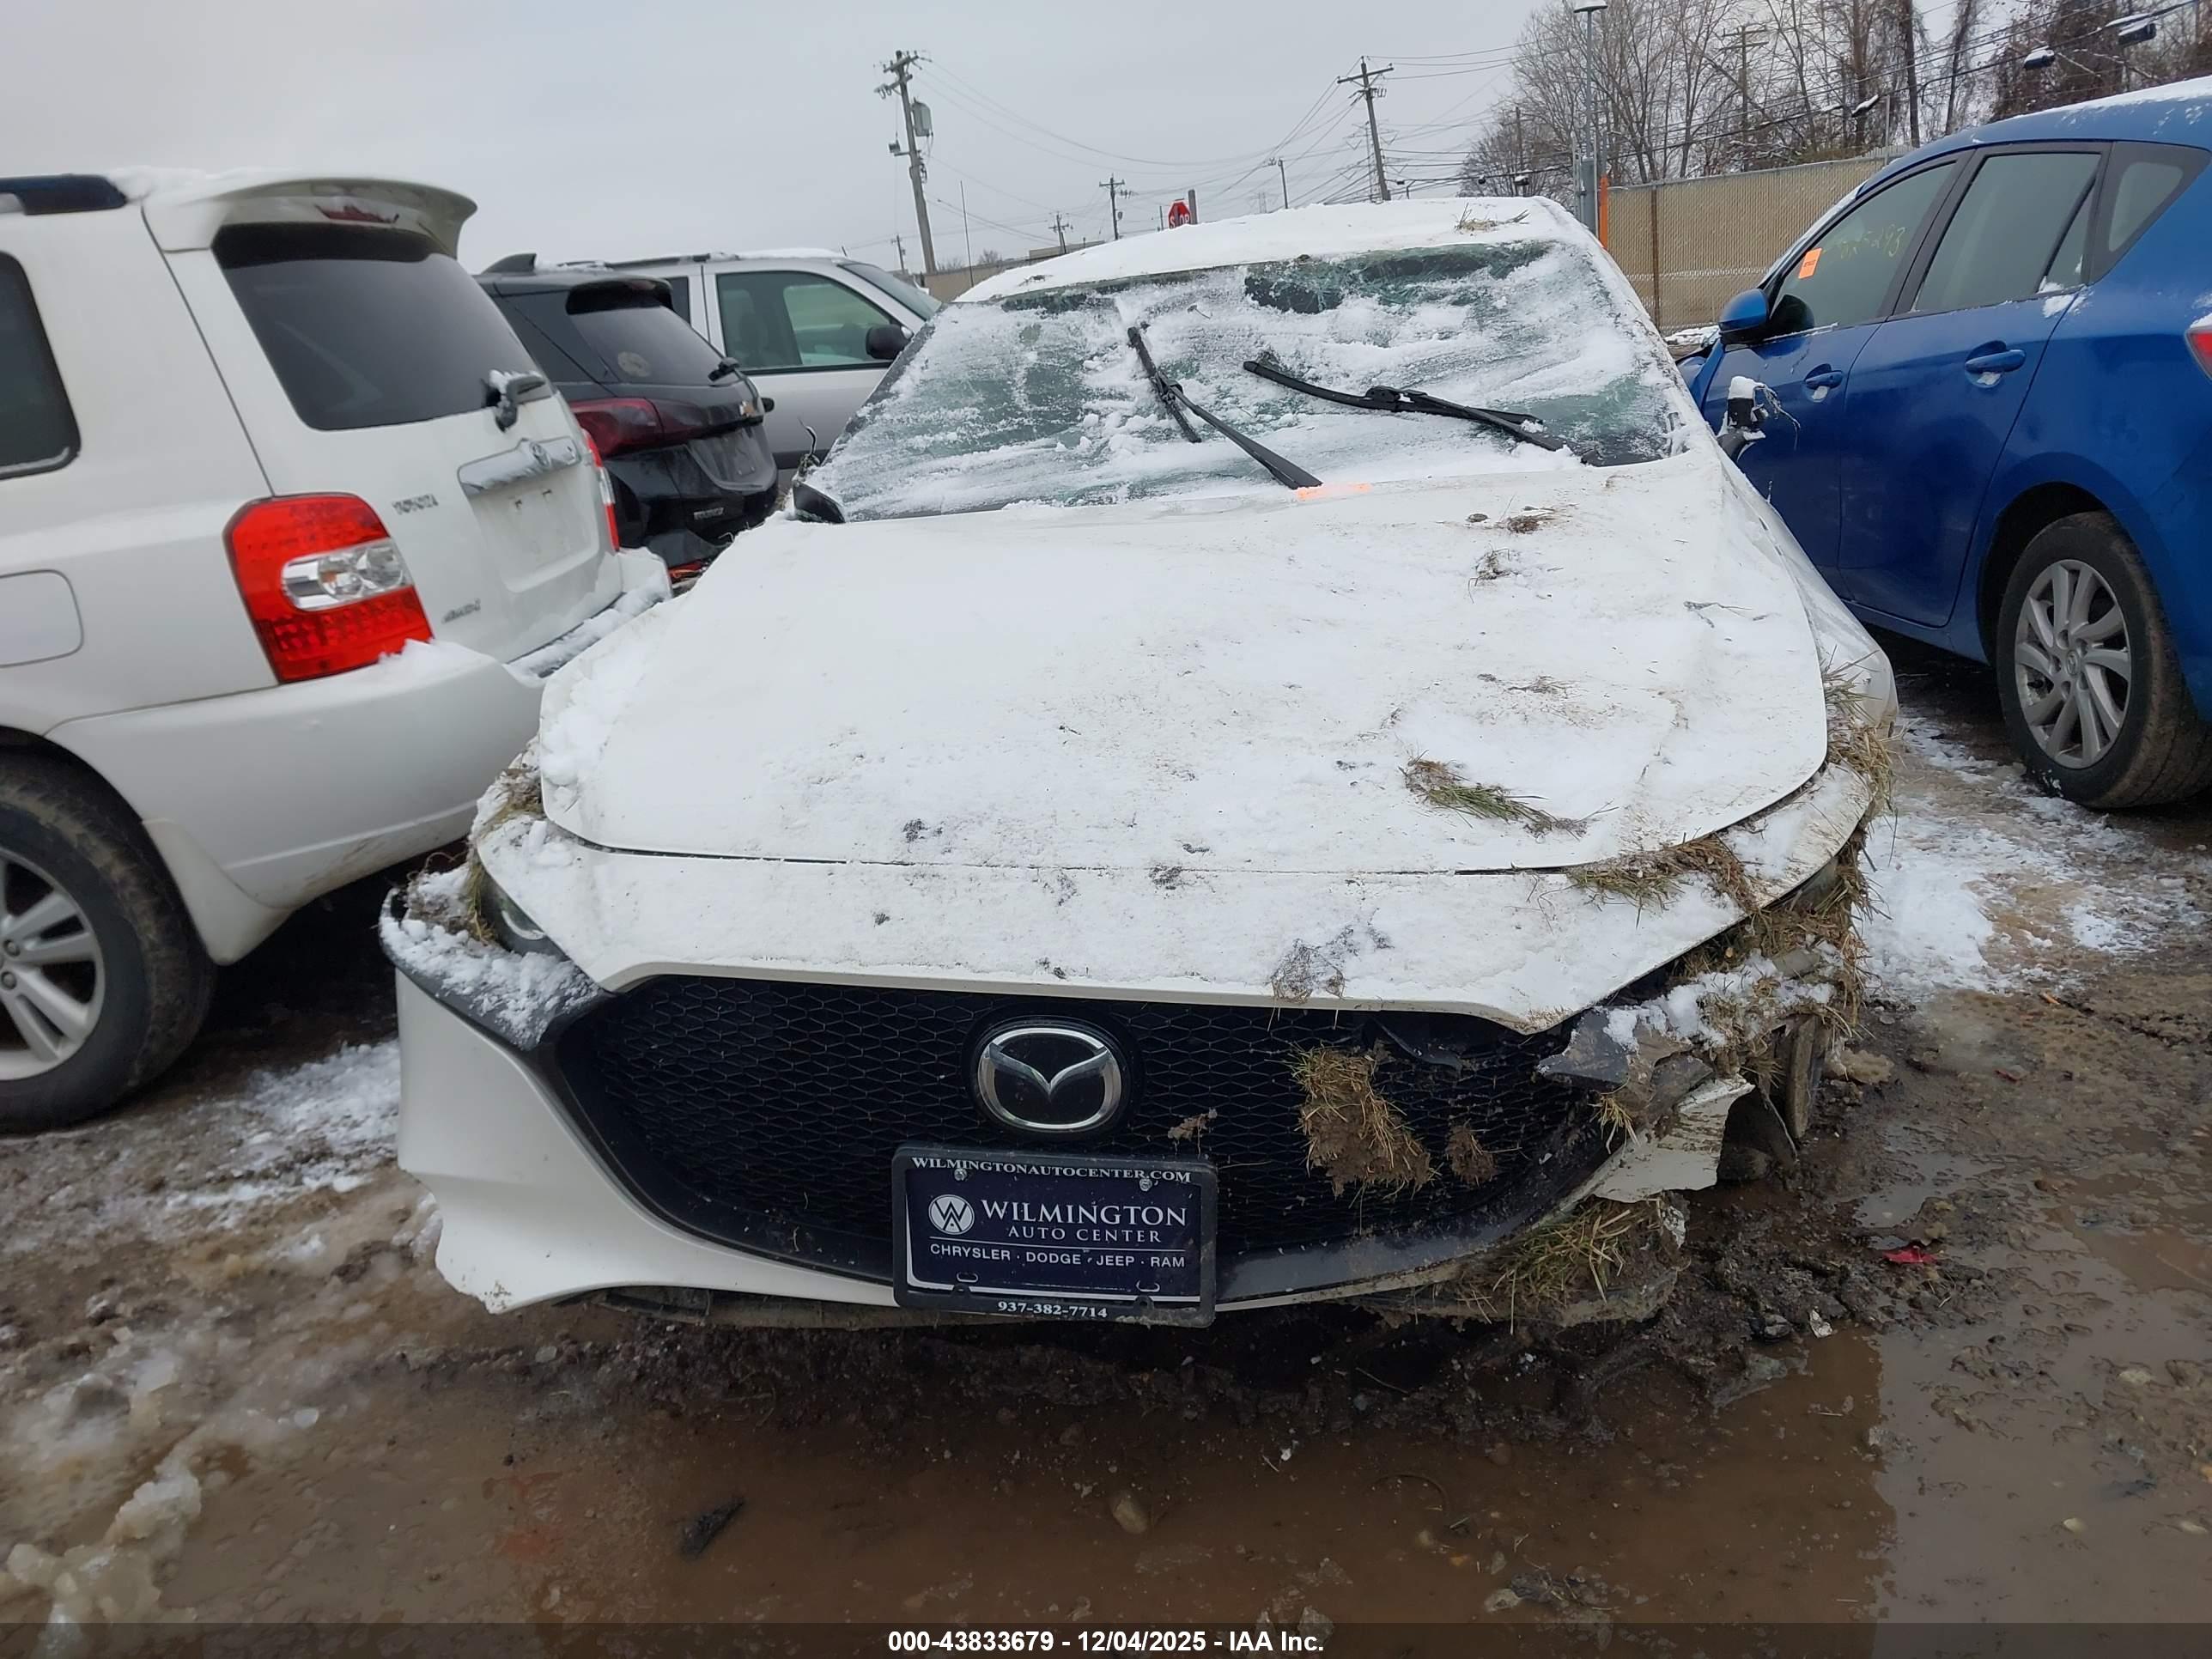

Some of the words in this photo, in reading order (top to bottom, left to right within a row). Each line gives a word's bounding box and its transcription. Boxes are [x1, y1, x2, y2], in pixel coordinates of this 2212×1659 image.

[911, 1157, 1191, 1183] WILMINGTONAUTOCENTER.COM
[981, 1200, 1187, 1226] WILMINGTON
[1008, 1225, 1066, 1240] AUTO
[1076, 1229, 1162, 1243] CENTER
[930, 1243, 1011, 1261] CHRYSLER
[1026, 1251, 1081, 1265] DODGE
[1096, 1255, 1135, 1267] JEEP
[1151, 1256, 1185, 1267] RAM
[998, 1301, 1108, 1318] 937-382-7714
